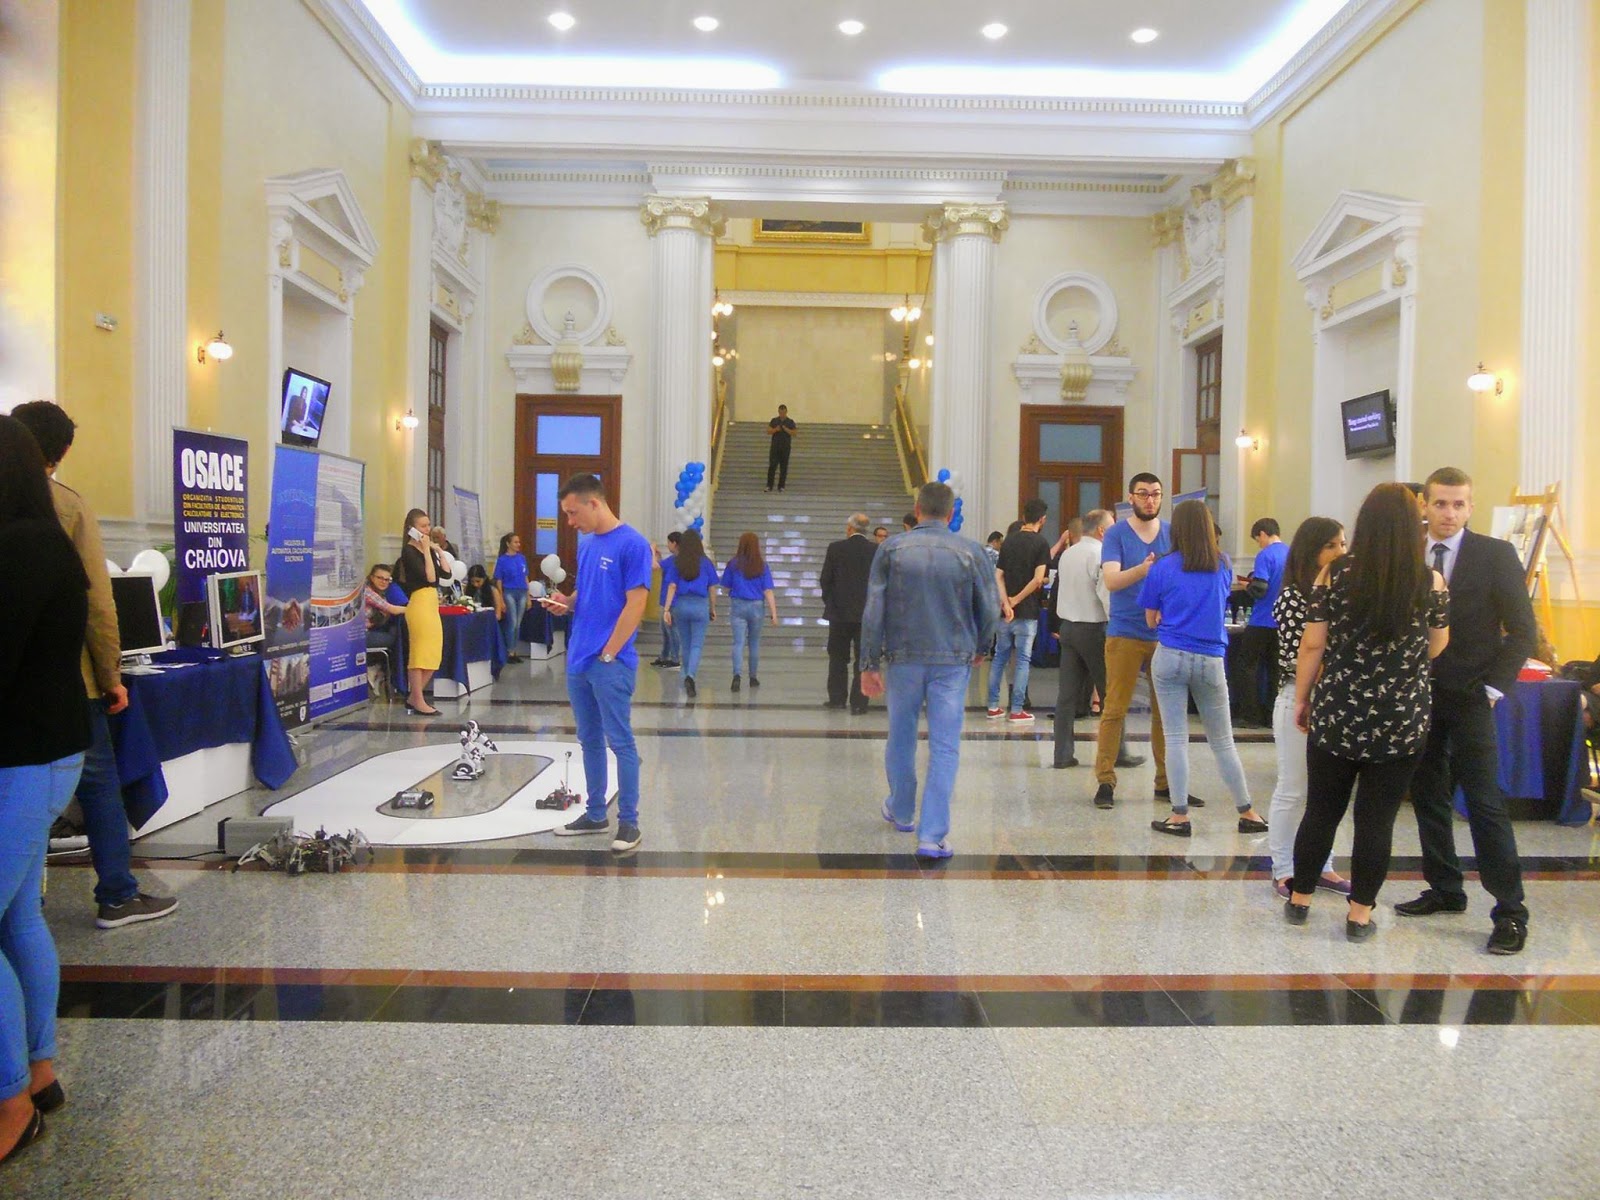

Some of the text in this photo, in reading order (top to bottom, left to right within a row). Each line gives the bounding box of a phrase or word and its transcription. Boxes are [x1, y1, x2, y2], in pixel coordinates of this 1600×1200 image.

[181, 448, 244, 492] OSACE
[184, 521, 245, 534] UNIVERSITATEA
[208, 537, 223, 549] DIN
[185, 549, 246, 569] CRAIOVA
